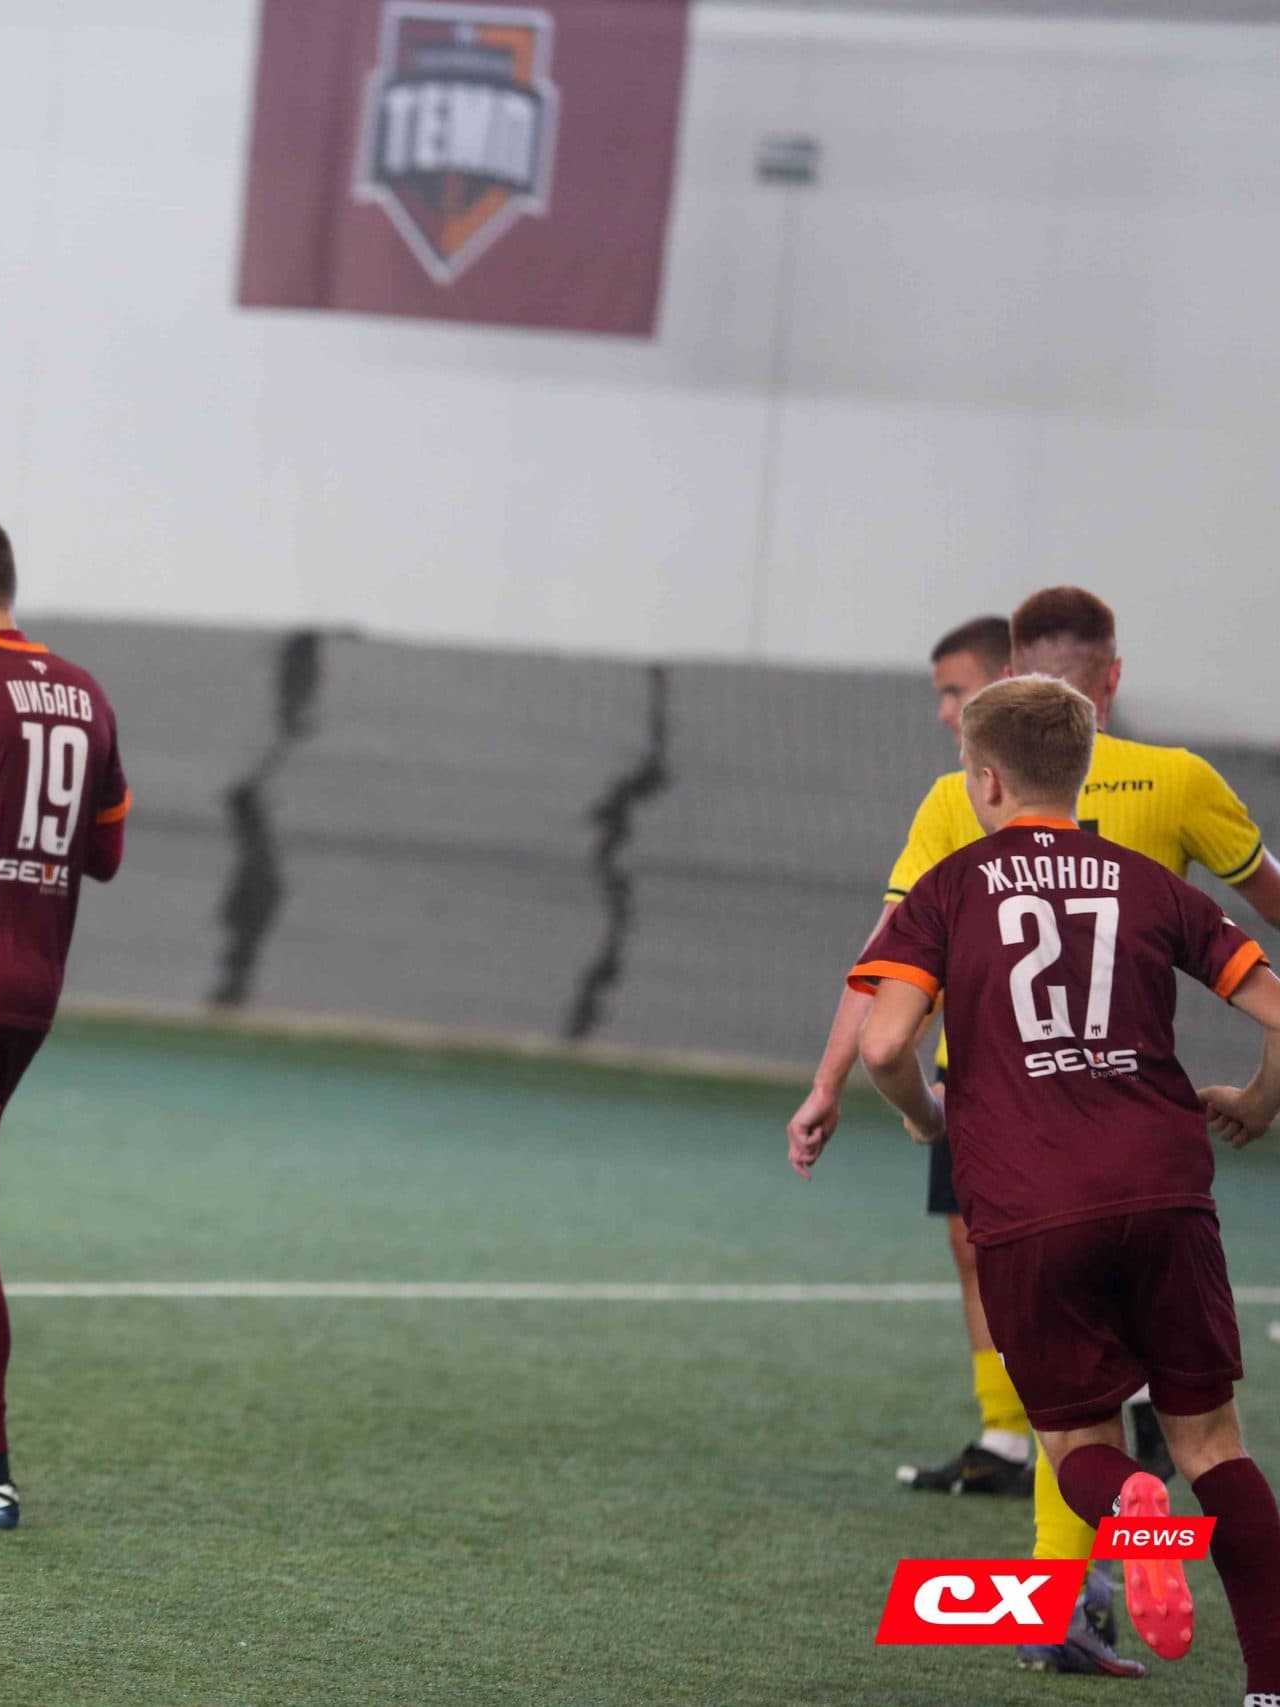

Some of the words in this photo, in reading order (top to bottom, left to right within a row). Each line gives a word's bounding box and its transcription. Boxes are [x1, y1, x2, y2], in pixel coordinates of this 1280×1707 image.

[6, 680, 93, 722] ШИБАЕВ
[17, 721, 88, 857] 19
[978, 855, 1121, 894] ЖДАНОВ
[997, 894, 1120, 1042] 27
